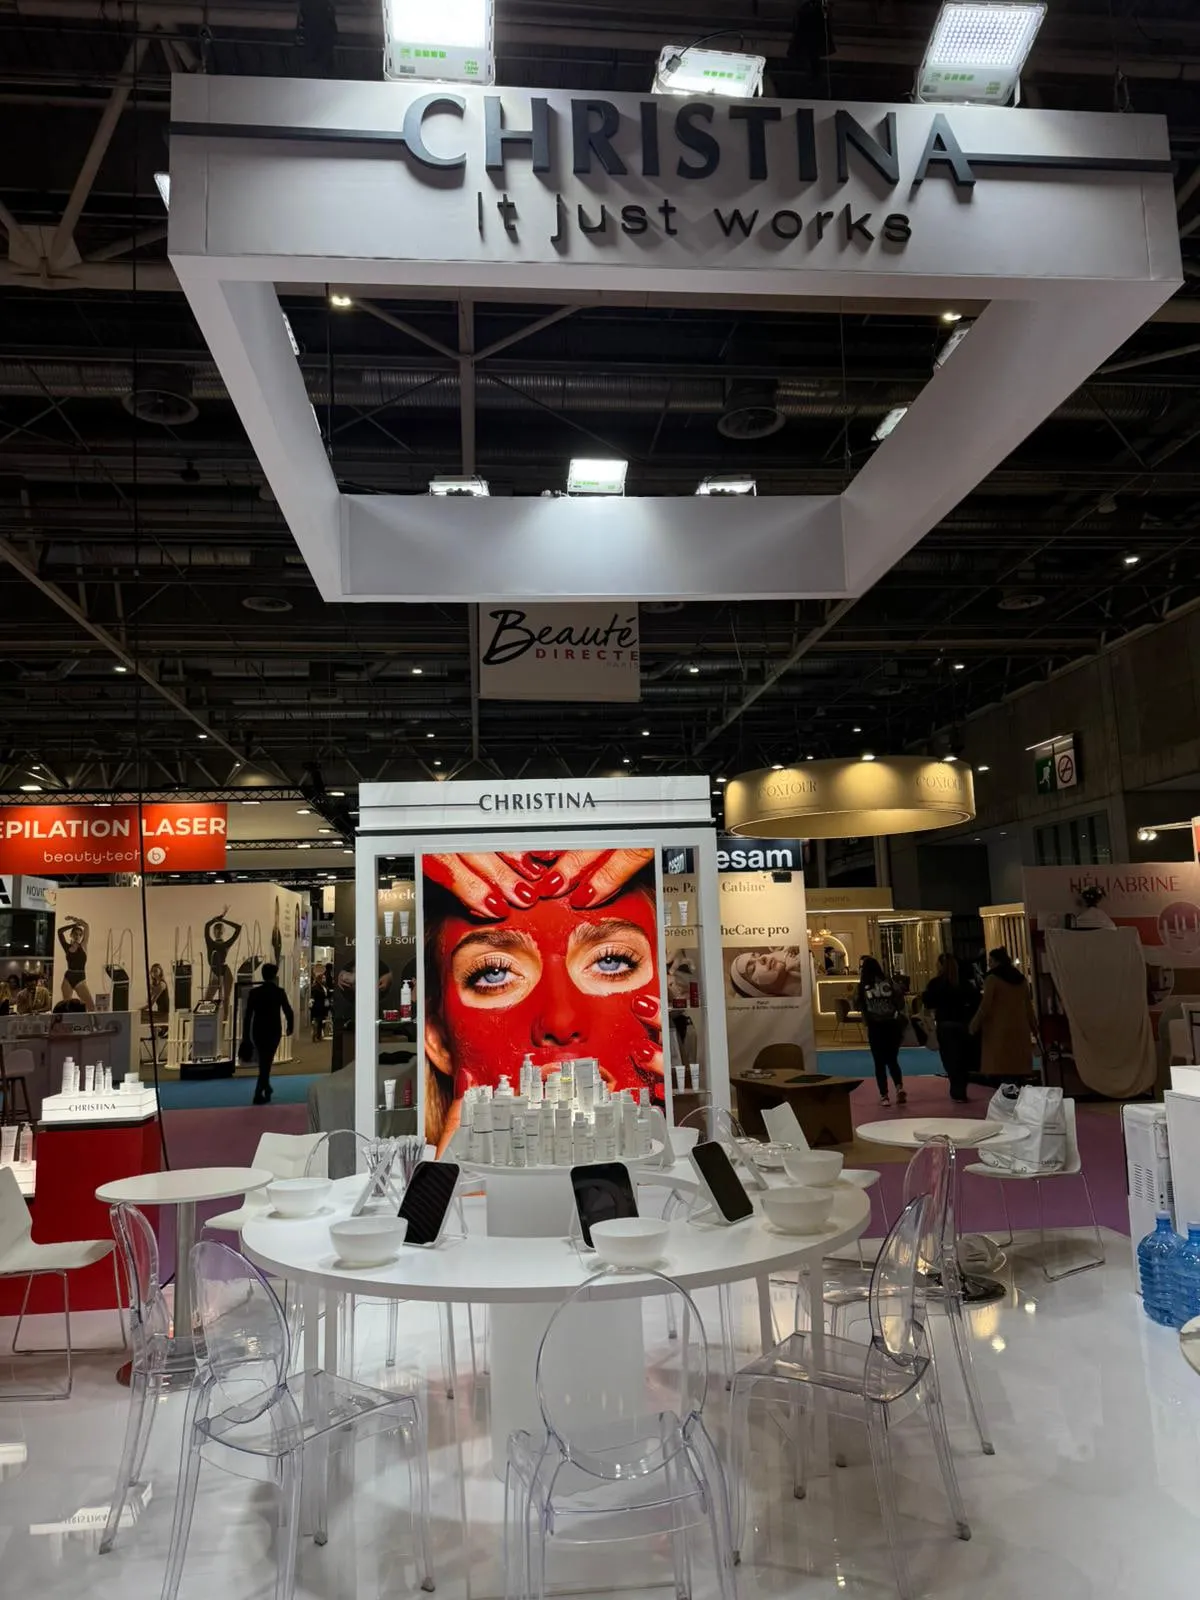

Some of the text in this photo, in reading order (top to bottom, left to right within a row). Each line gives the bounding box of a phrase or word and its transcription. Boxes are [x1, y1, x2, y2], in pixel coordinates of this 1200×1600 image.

[402, 92, 976, 187] CHRISTINA
[477, 191, 912, 243] It just works
[482, 609, 638, 665] Beauté
[535, 647, 639, 661] DIRECTE
[479, 792, 596, 811] CHRISTINA
[142, 817, 226, 837] LASER
[768, 926, 789, 937] pro
[68, 1103, 117, 1112] CHRISTINA
